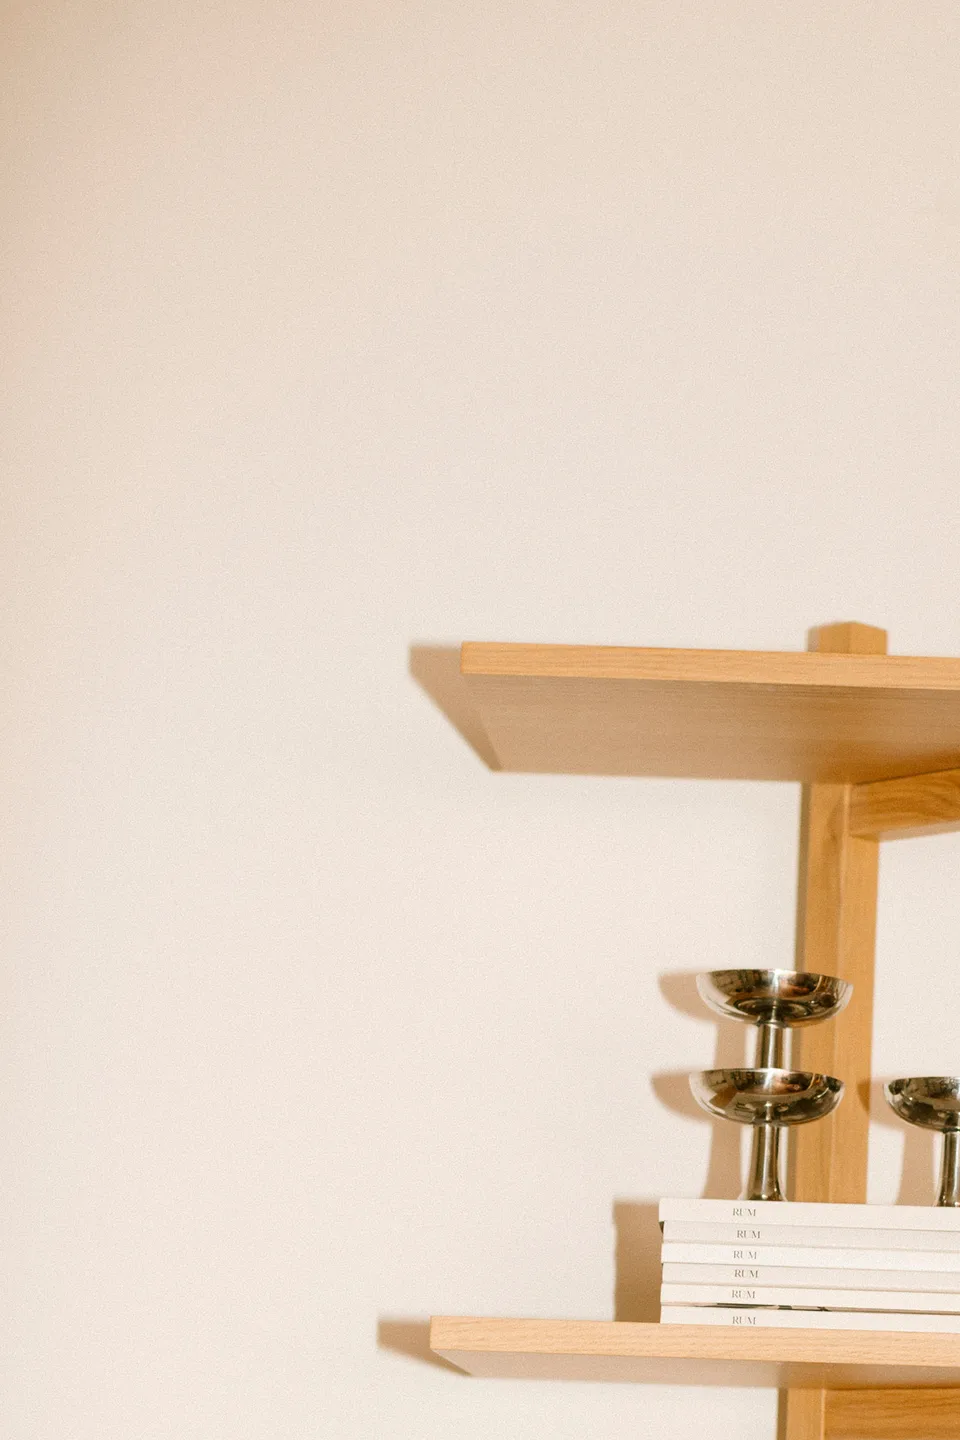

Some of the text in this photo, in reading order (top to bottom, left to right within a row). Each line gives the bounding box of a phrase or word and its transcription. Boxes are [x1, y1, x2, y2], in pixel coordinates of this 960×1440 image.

[732, 1208, 757, 1217] RUM
[736, 1230, 761, 1239] RUM
[733, 1250, 757, 1260] RUM
[734, 1269, 759, 1279] RUM
[731, 1289, 756, 1299] RUM
[732, 1316, 756, 1325] RUM
